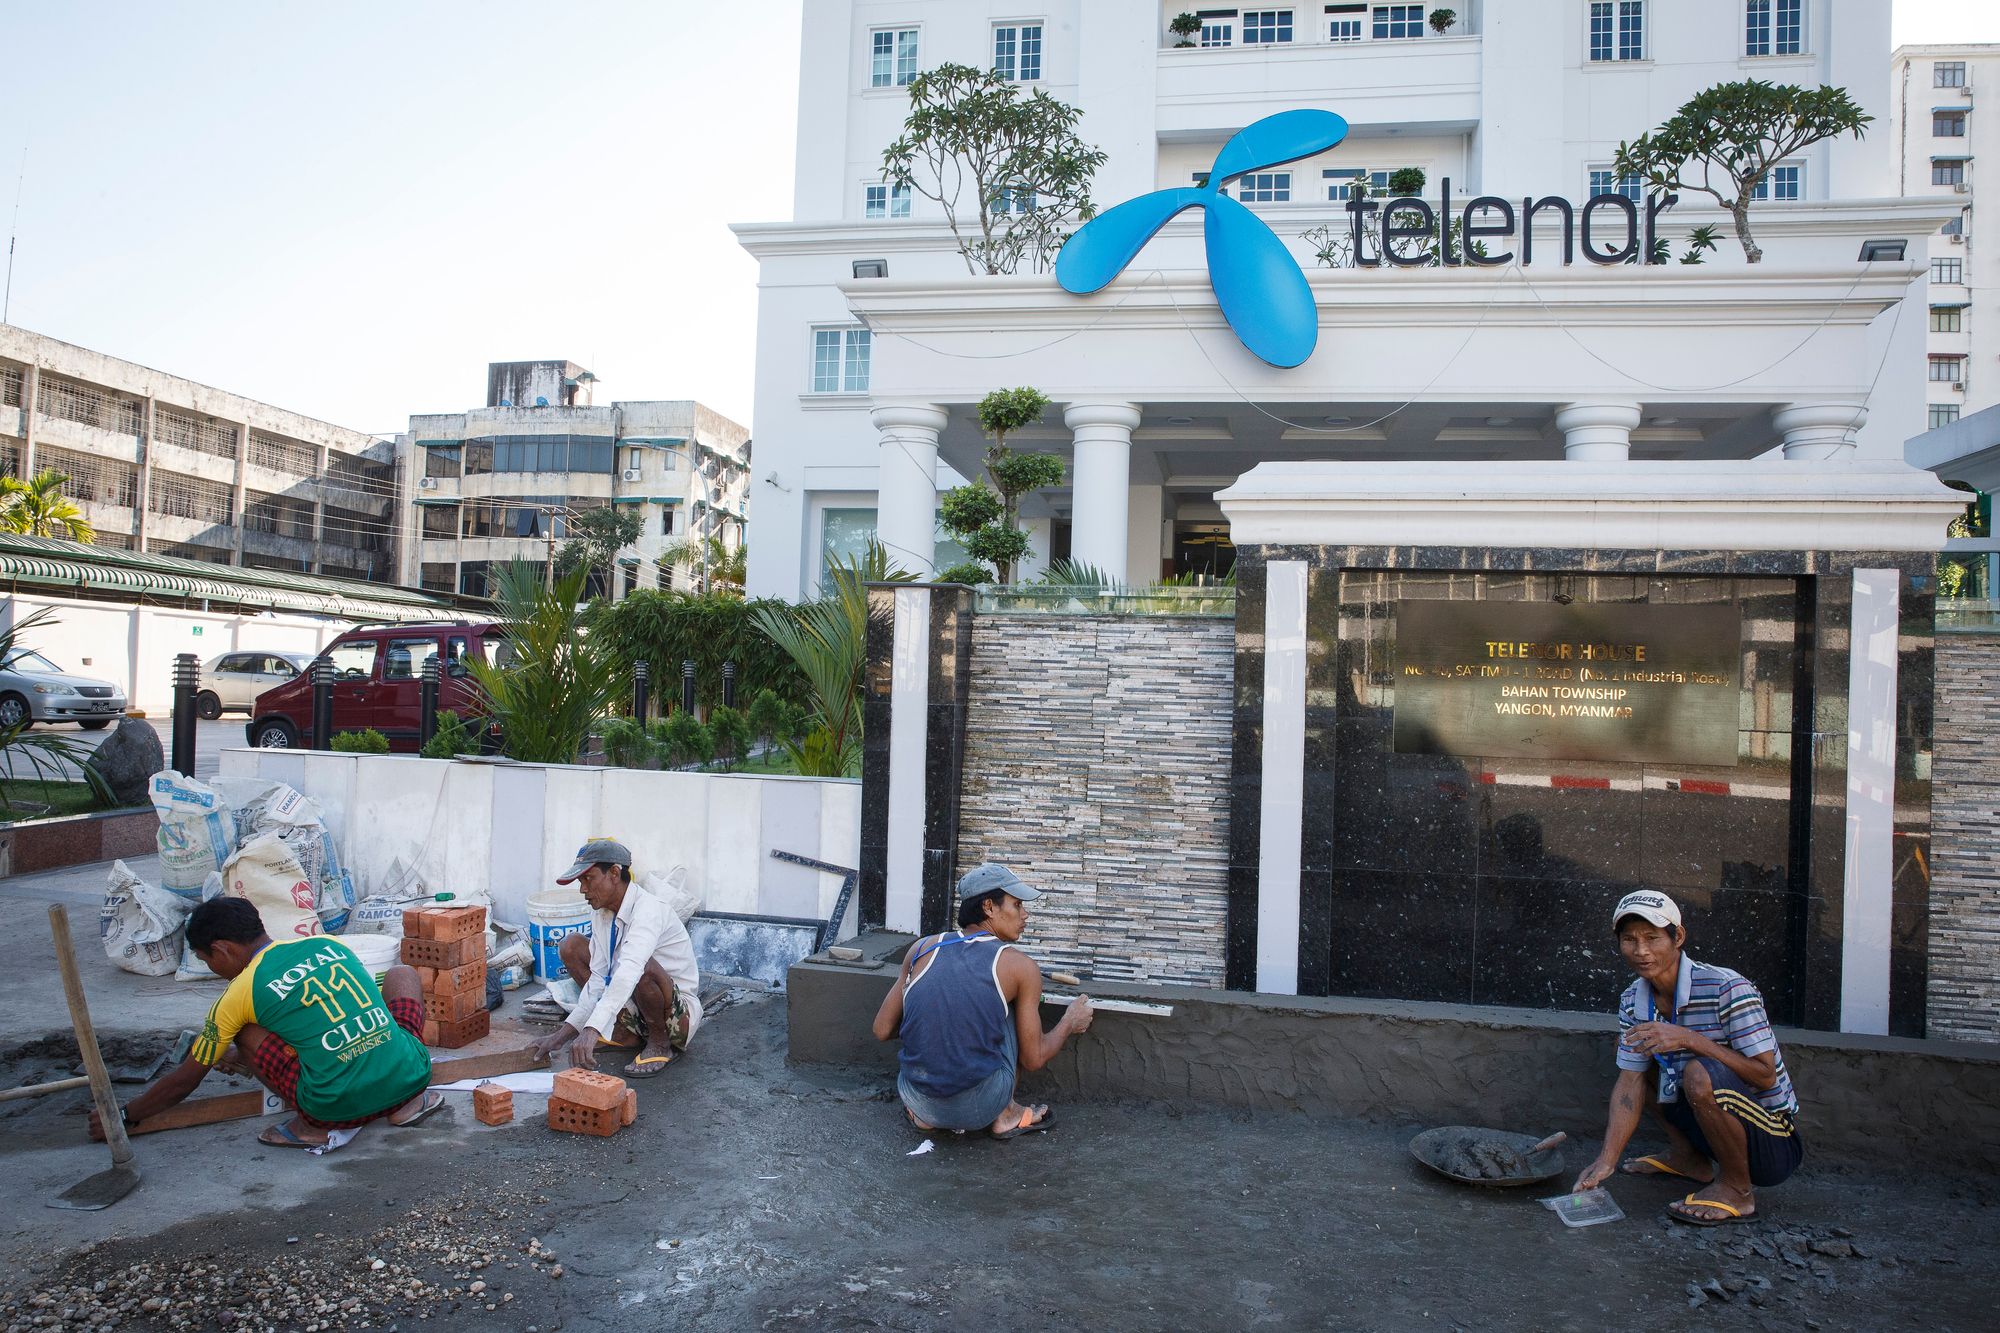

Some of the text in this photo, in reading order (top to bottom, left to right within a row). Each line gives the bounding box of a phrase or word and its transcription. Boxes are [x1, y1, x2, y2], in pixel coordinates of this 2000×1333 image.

[1345, 177, 1679, 267] telenor
[1485, 641, 1647, 662] TELENOR HOUSE
[1501, 685, 1627, 700] BAHAN TOWNSHIP
[1495, 702, 1633, 719] YANGON, MYANMAR
[281, 792, 299, 812] RAMCO
[357, 908, 403, 920] RAMCO
[266, 945, 348, 1001] ROYAL
[300, 966, 373, 1024] 11
[320, 1007, 390, 1052] CLUB
[336, 1030, 393, 1064] WHISKY
